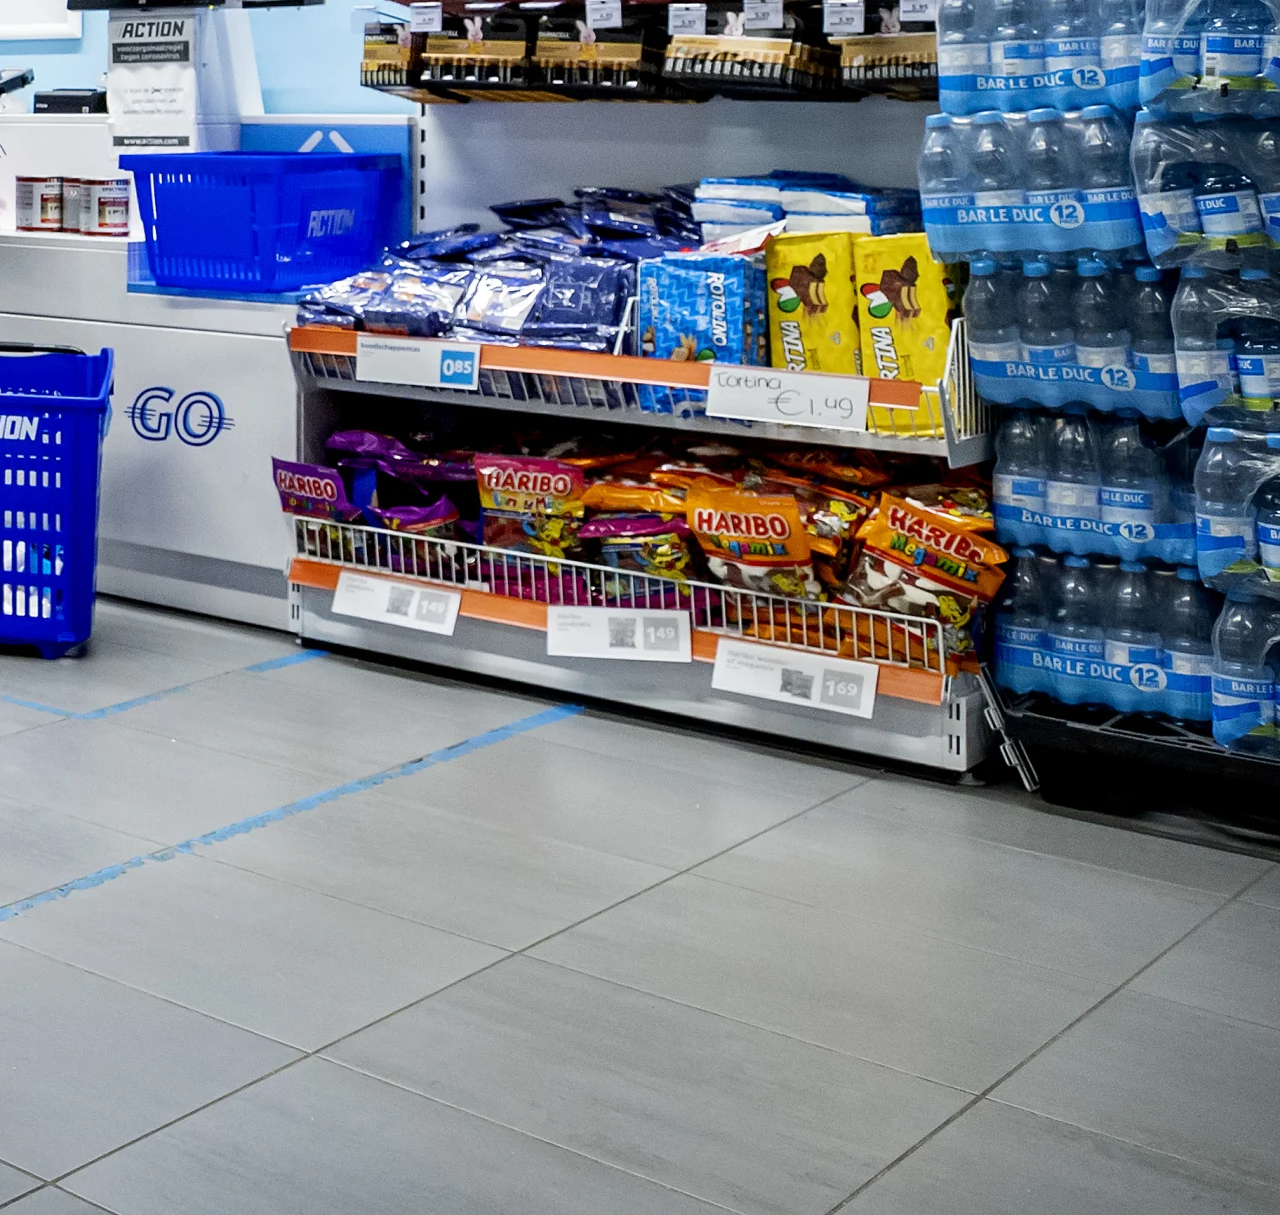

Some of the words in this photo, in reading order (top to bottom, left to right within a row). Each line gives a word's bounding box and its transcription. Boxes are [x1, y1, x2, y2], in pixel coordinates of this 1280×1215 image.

[122, 21, 185, 38] ACTION
[307, 209, 355, 237] ACTION
[958, 209, 987, 223] BAR
[990, 209, 1009, 222] LE
[1012, 209, 1043, 222] DUC
[1055, 205, 1078, 220] 12
[706, 271, 727, 348] ROTOLINO
[442, 357, 473, 377] 085
[871, 327, 899, 382] RTINA
[714, 372, 782, 390] Tortina
[130, 386, 228, 447] GO
[278, 472, 336, 501] HARIBO
[489, 468, 571, 495] HARIBO
[697, 509, 789, 539] HARIBO
[891, 533, 980, 583] Megamix
[646, 625, 675, 643] 149
[1032, 653, 1063, 672] BAR
[1066, 662, 1085, 676] LE
[1090, 664, 1122, 681] DUC
[1134, 667, 1159, 683] 12
[825, 680, 858, 697] 169
